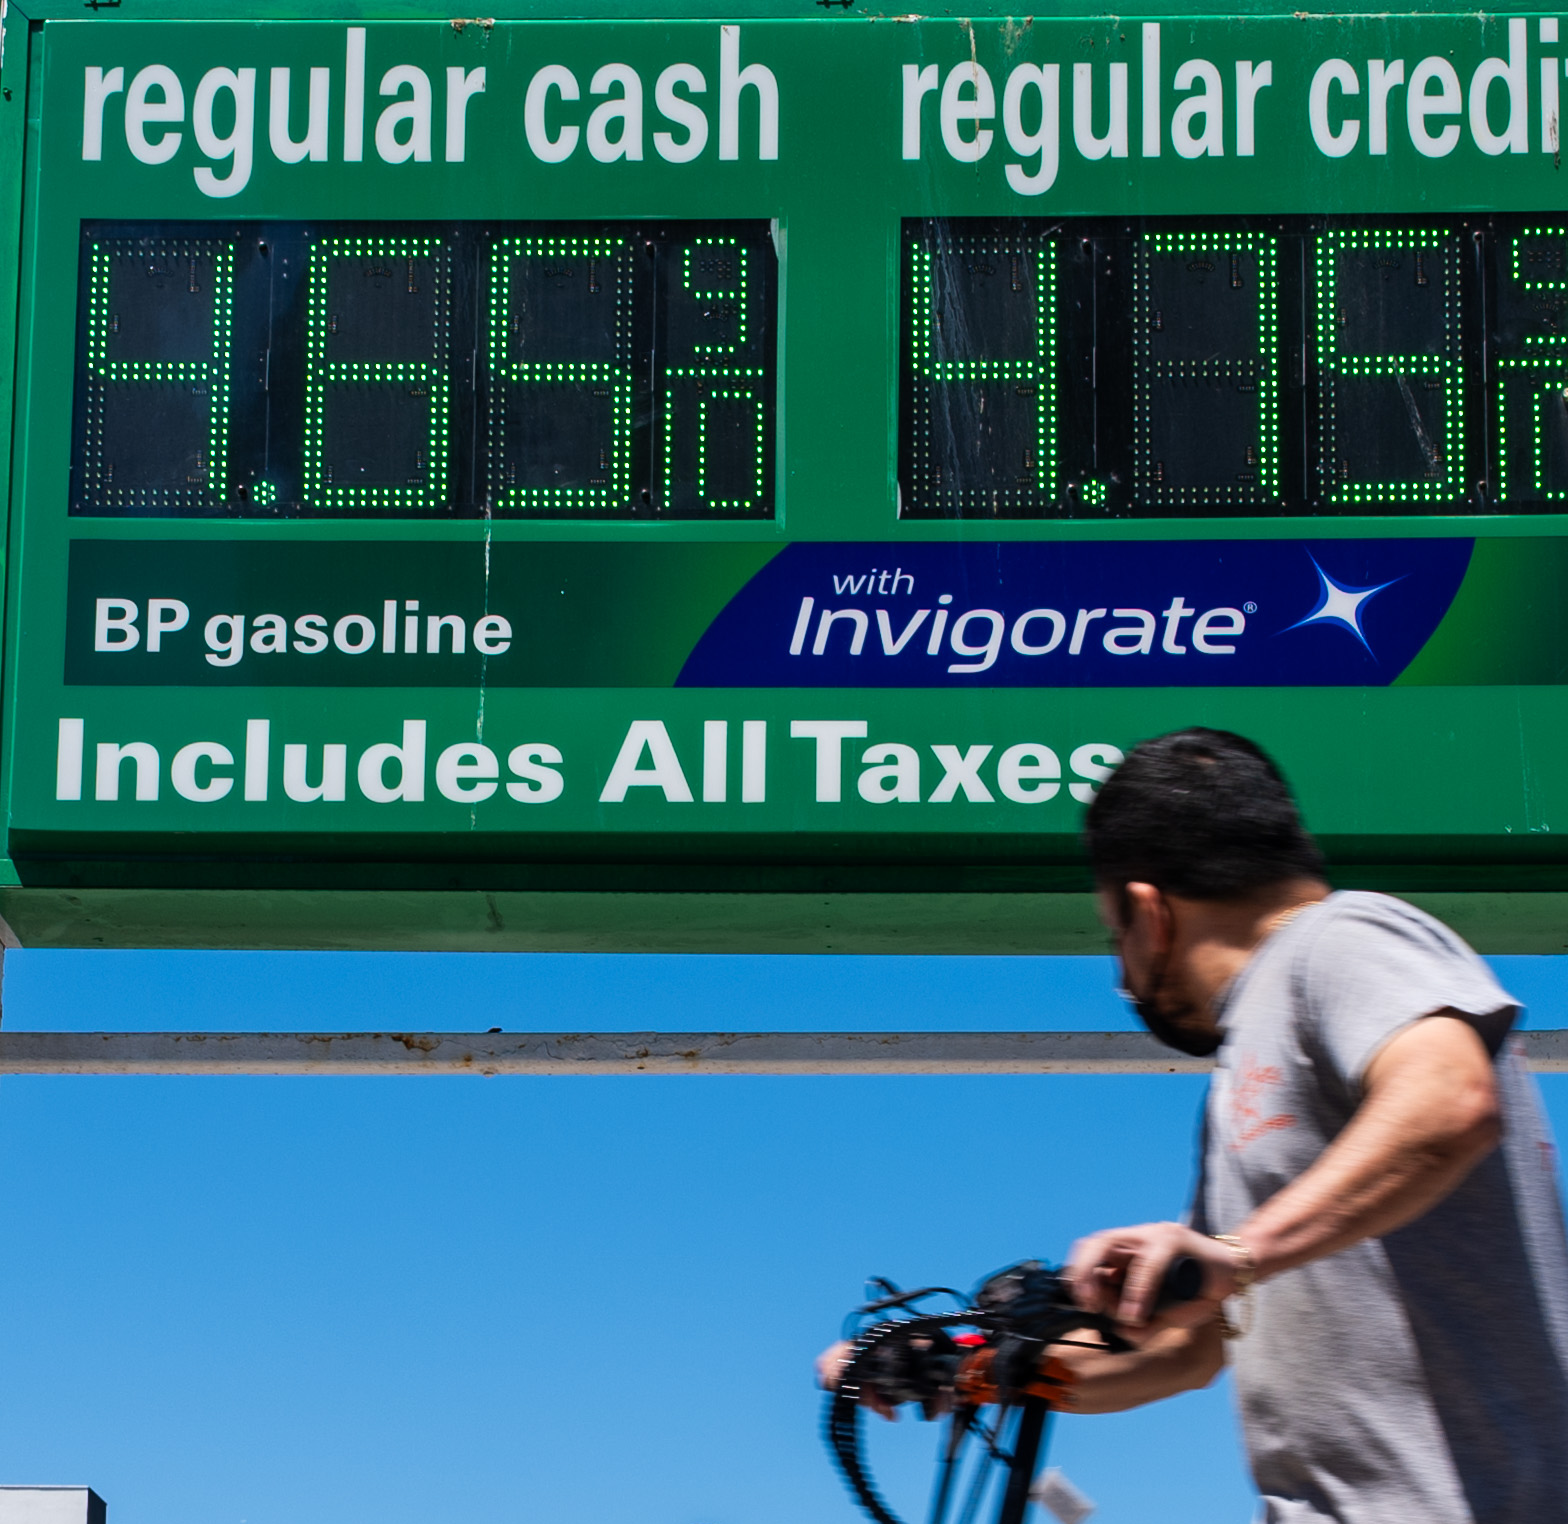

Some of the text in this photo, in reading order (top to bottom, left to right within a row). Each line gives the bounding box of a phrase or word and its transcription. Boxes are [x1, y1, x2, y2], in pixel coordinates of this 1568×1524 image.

[82, 25, 779, 198] regular cash
[901, 22, 1272, 196] regular
[88, 237, 631, 508] 4.65
[912, 229, 1465, 503] 4.75
[93, 597, 513, 667] BP gasoline
[832, 567, 915, 597] with
[56, 718, 1126, 804] Includes All Taxes
